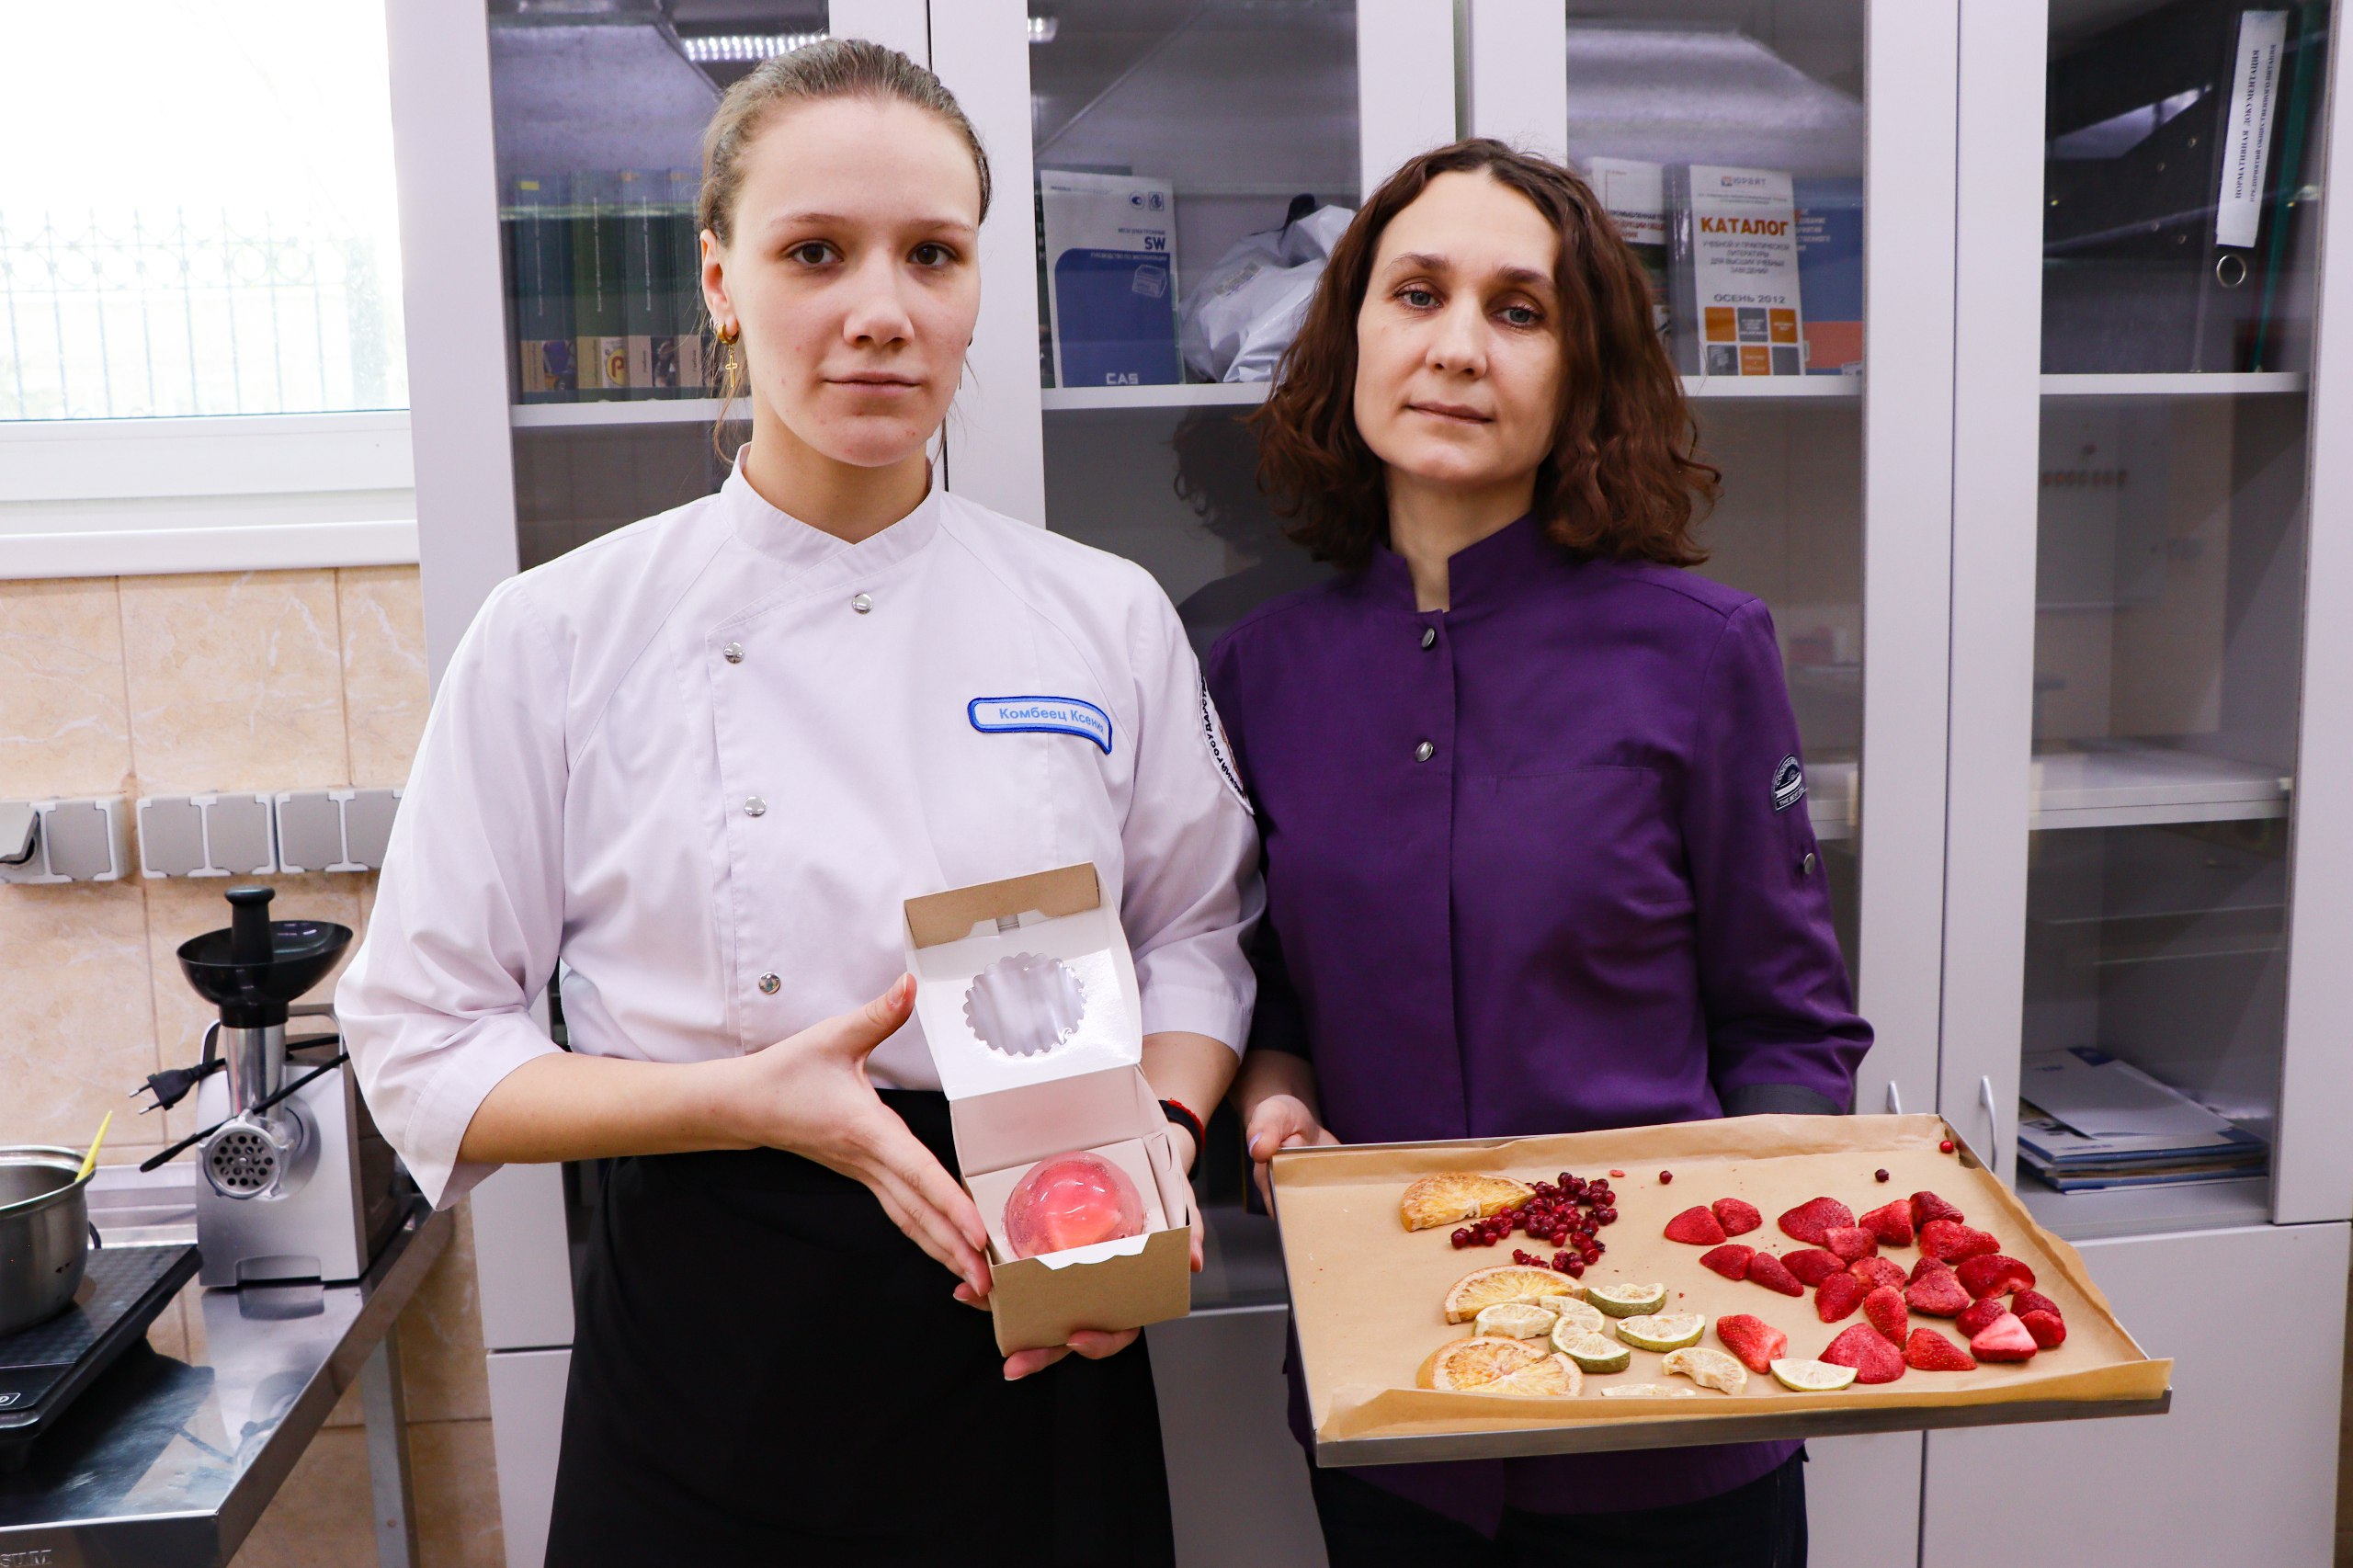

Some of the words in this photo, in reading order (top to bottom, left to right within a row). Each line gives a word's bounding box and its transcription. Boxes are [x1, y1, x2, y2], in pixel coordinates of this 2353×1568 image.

[2234, 131, 2250, 199] НОРМАТИВНАЯ
[2245, 49, 2260, 127] ДОКУМЕНТАЦИЯ
[1701, 217, 1790, 236] КАТАЛОГ
[1144, 236, 1166, 251] SW
[1713, 294, 1755, 302] ОСЕНЬ
[1757, 294, 1787, 304] 2012
[1106, 372, 1139, 385] CAS
[999, 707, 1067, 722] Комбеец
